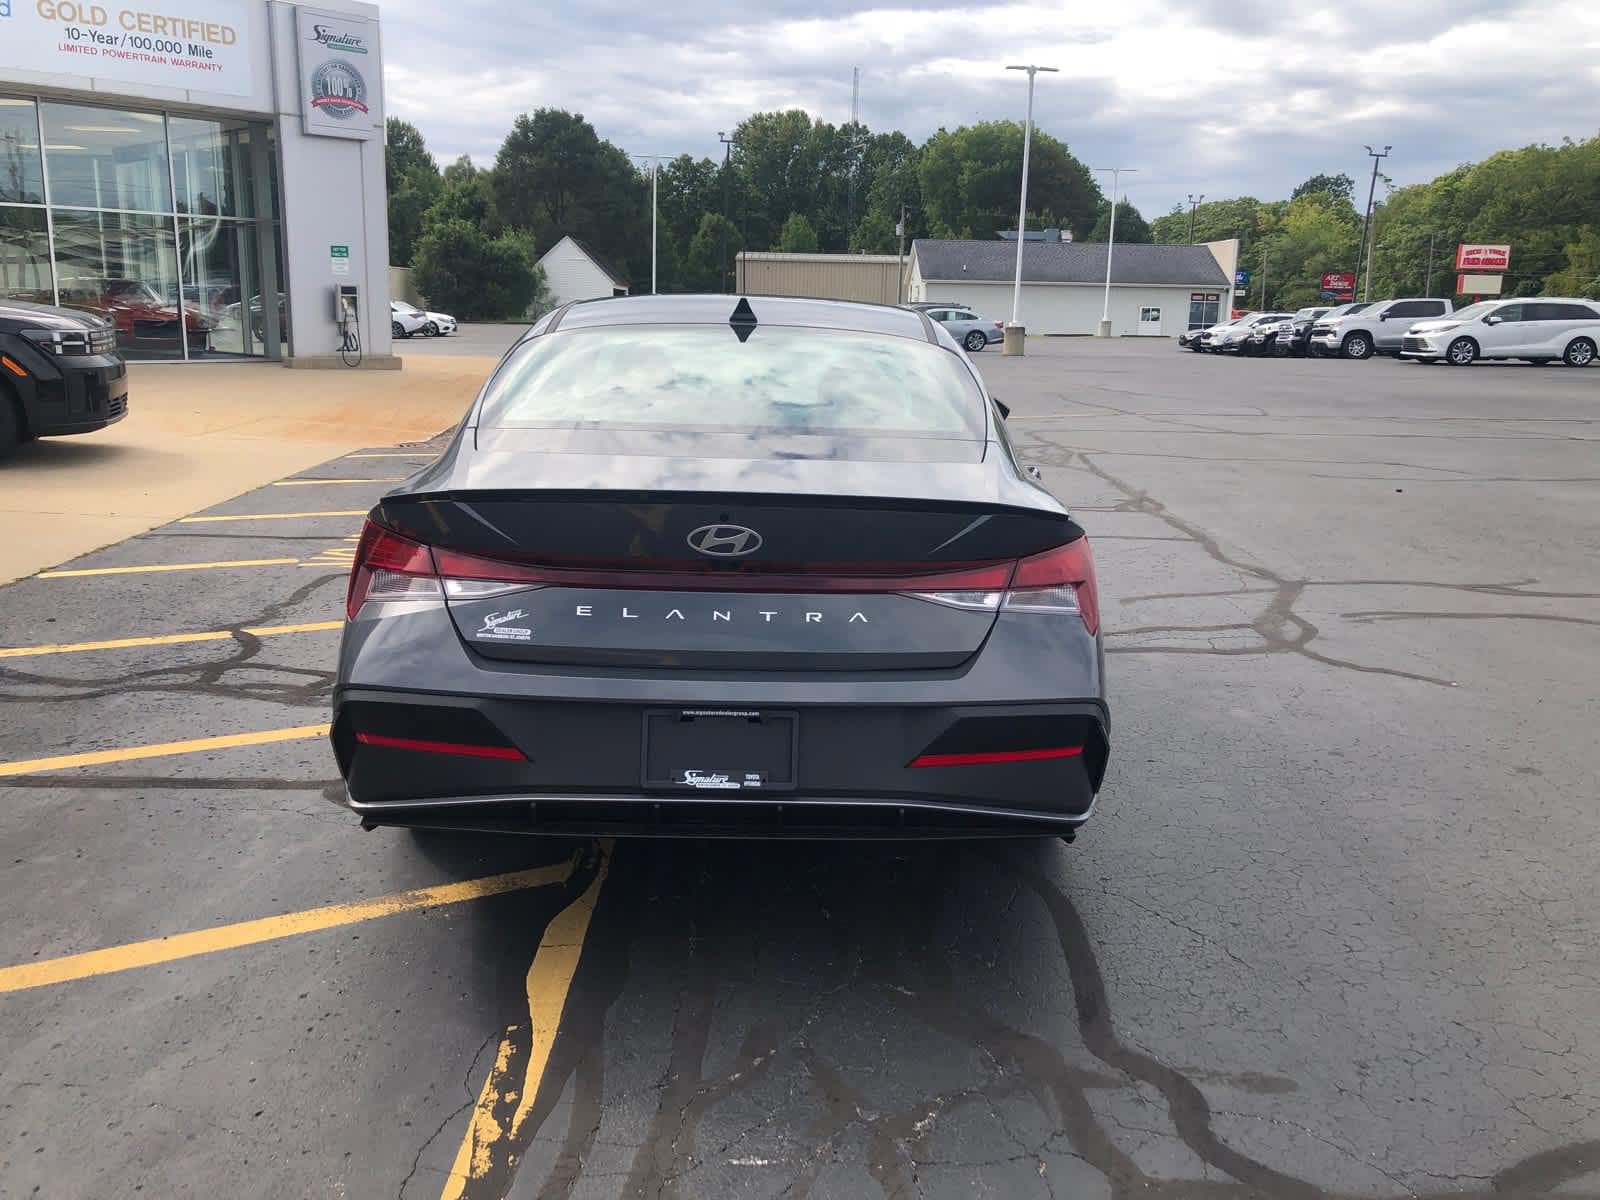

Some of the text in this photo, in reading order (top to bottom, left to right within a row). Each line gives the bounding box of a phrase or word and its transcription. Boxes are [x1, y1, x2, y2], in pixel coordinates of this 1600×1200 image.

[36, 0, 237, 46] GOLD CERTIFIED
[306, 24, 362, 45] Signature
[64, 27, 213, 59] 10-Year/100,000 Mile
[58, 42, 224, 72] LIMITED POWERTRAIN WARRANTY
[326, 75, 354, 98] 100%
[576, 604, 869, 624] ELANTRA
[676, 770, 729, 785] Signature
